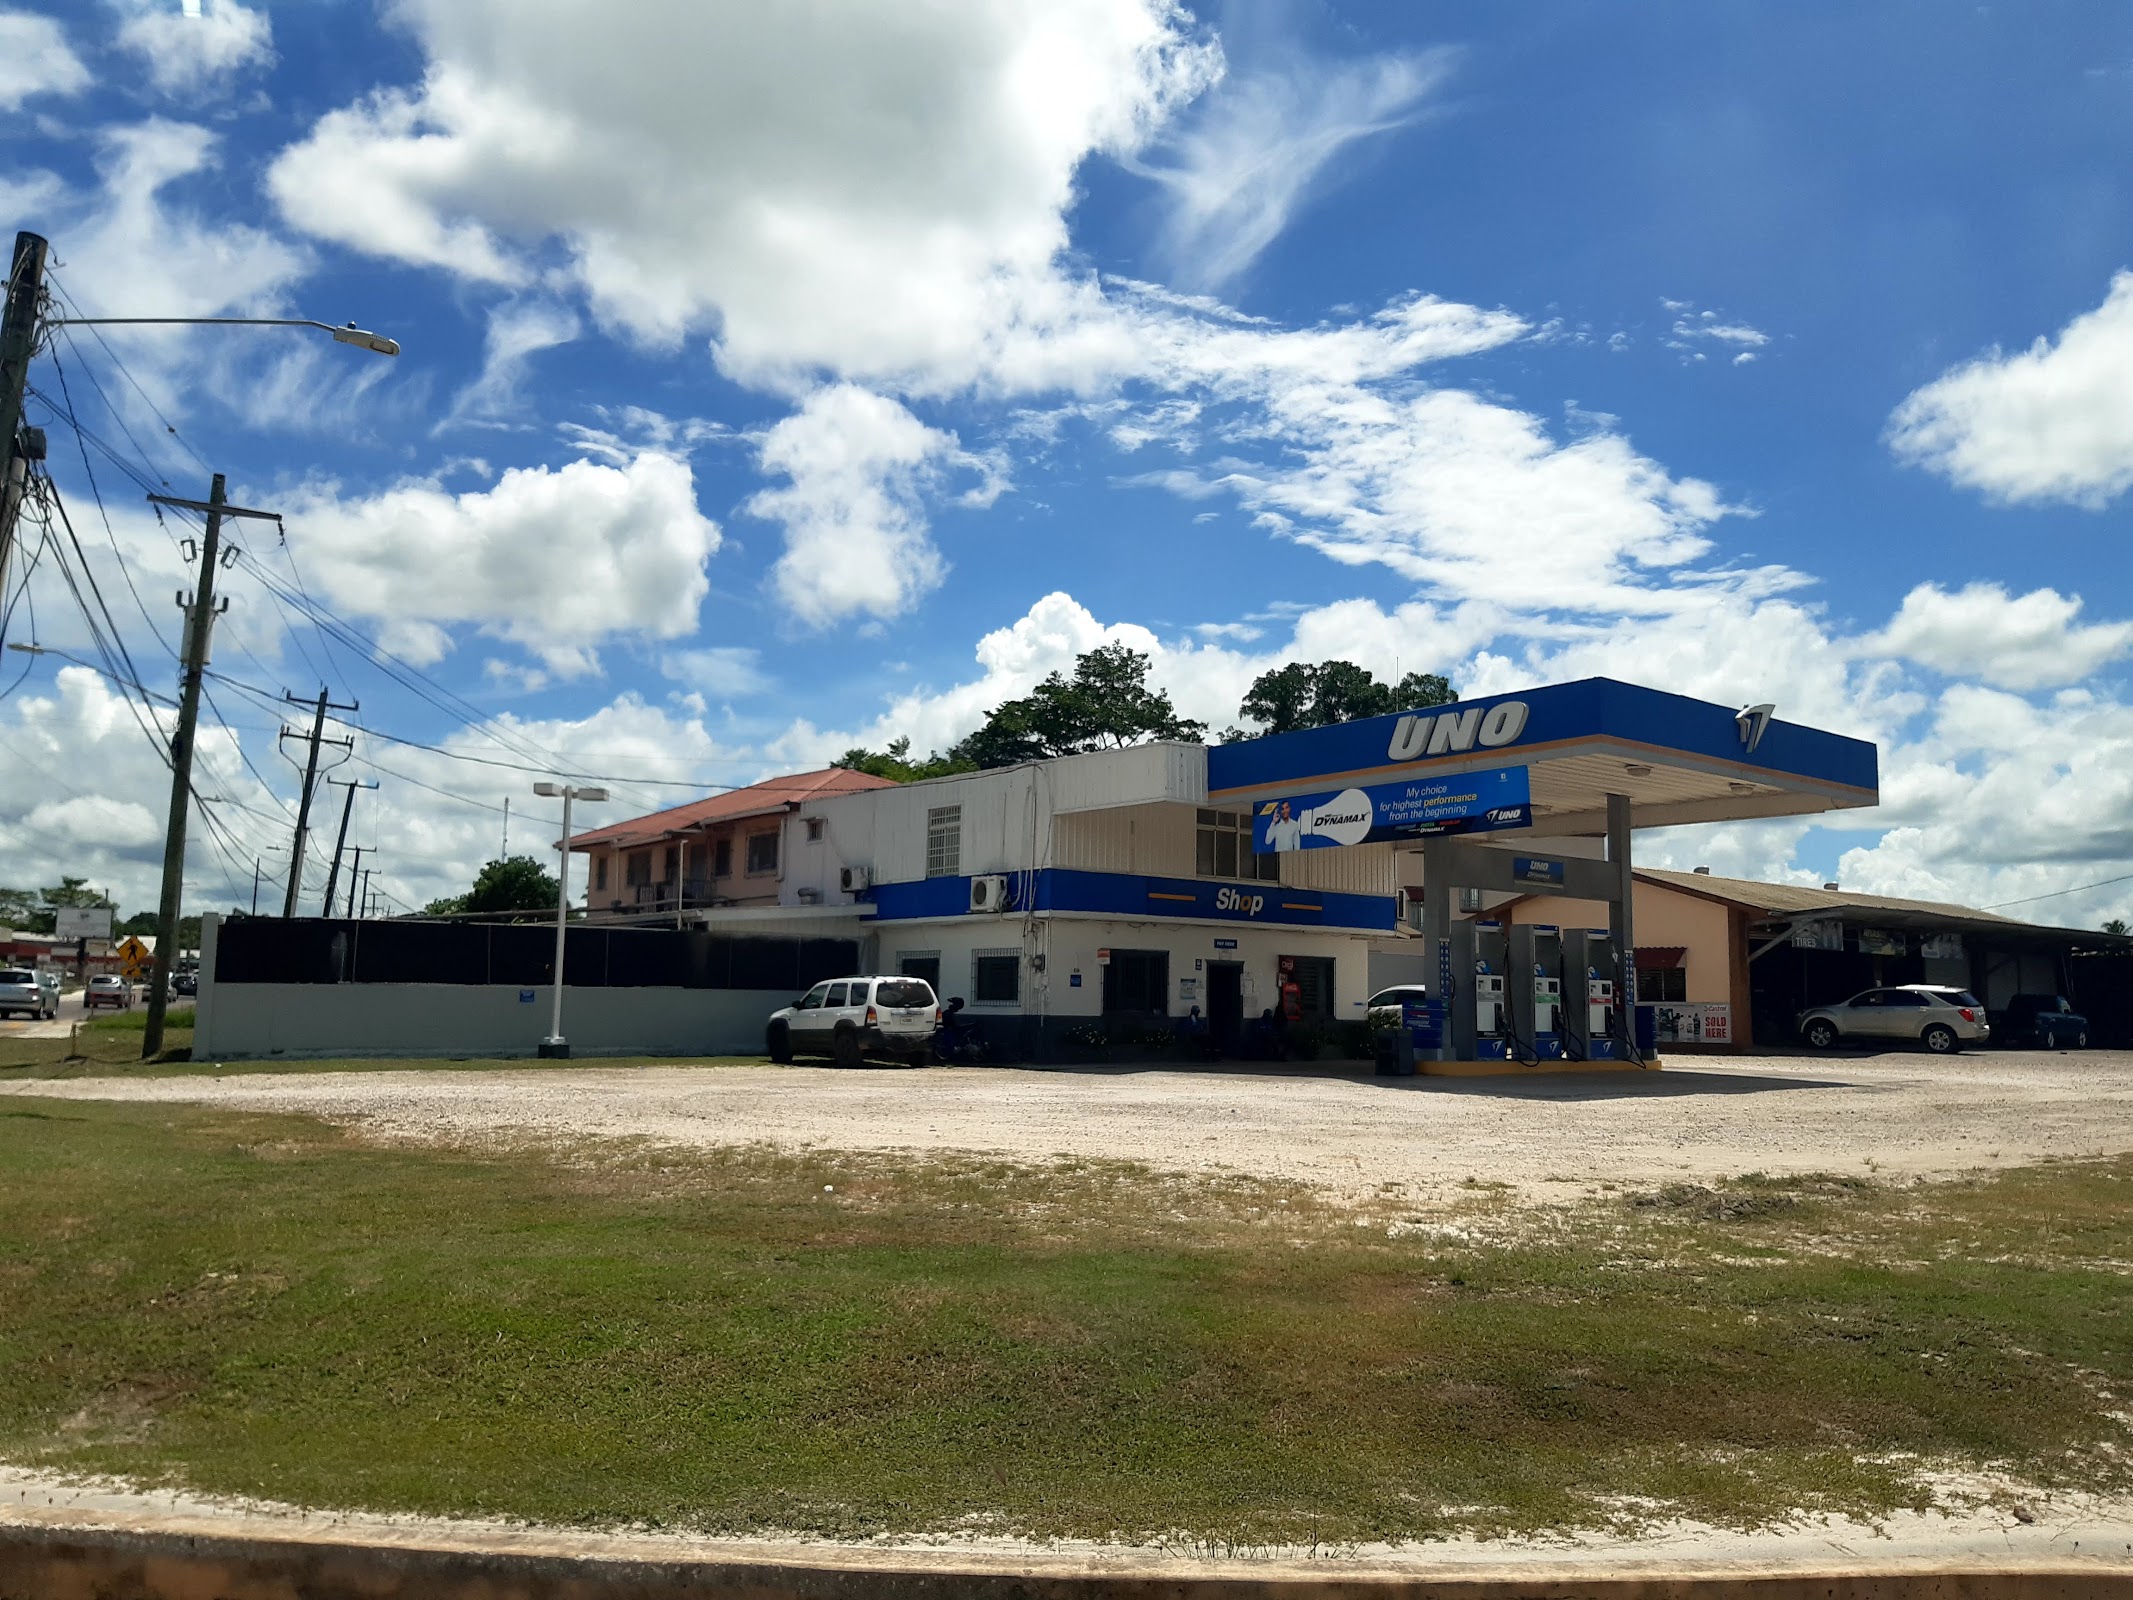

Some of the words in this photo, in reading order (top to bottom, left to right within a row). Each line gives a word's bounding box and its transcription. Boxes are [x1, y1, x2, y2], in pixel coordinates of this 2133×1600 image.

[1388, 701, 1529, 760] UNO
[1406, 787, 1418, 798] My
[1421, 784, 1447, 796] choice
[1379, 802, 1391, 812] for
[1393, 799, 1422, 812] highest
[1423, 793, 1477, 808] performance
[1314, 812, 1368, 827] DYNAMAX
[1389, 811, 1408, 821] from
[1410, 809, 1423, 819] the
[1425, 805, 1467, 817] beginning
[1498, 809, 1521, 820] UNO
[1530, 860, 1549, 871] UNO
[1215, 887, 1264, 916] Shop
[1795, 937, 1816, 948] TIRES
[1705, 1016, 1727, 1027] SOLD
[1705, 1027, 1727, 1038] HERE
